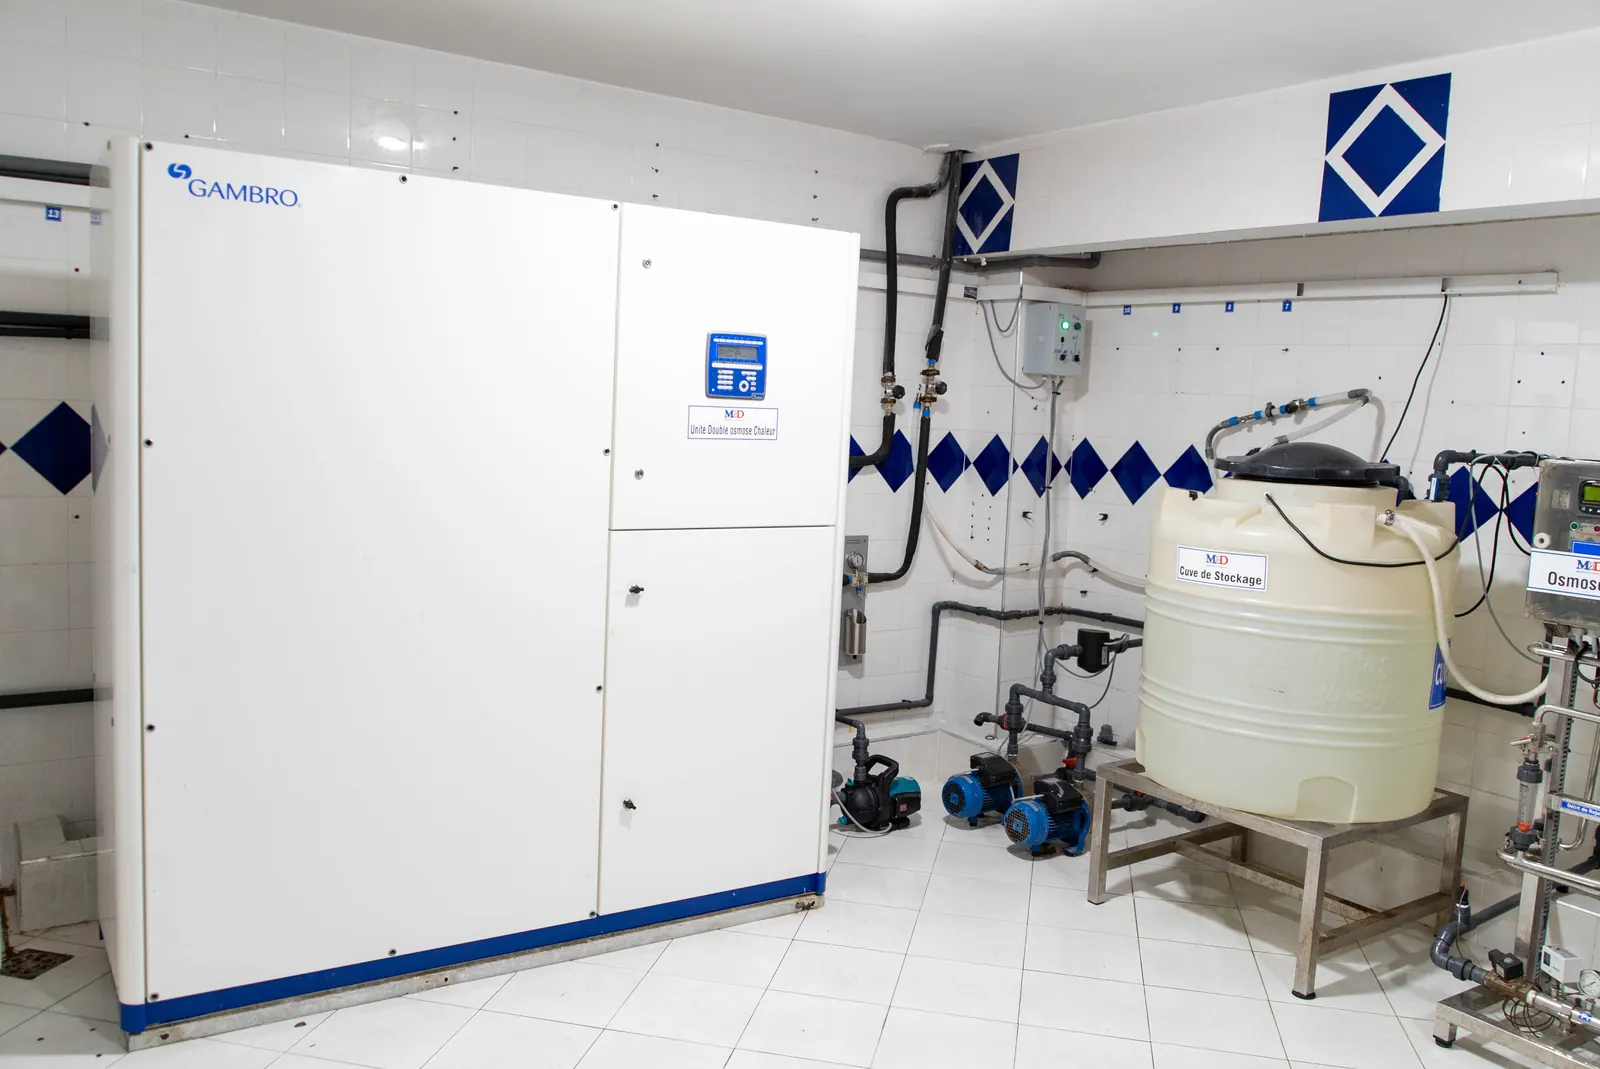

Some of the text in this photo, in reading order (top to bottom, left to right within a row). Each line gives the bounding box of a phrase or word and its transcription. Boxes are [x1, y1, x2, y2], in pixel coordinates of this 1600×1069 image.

[188, 178, 298, 207] GAMBRO
[47, 208, 60, 219] 13
[690, 424, 776, 436] Unite Double osmose Chaleur
[1179, 565, 1262, 587] Cuve de Stockage
